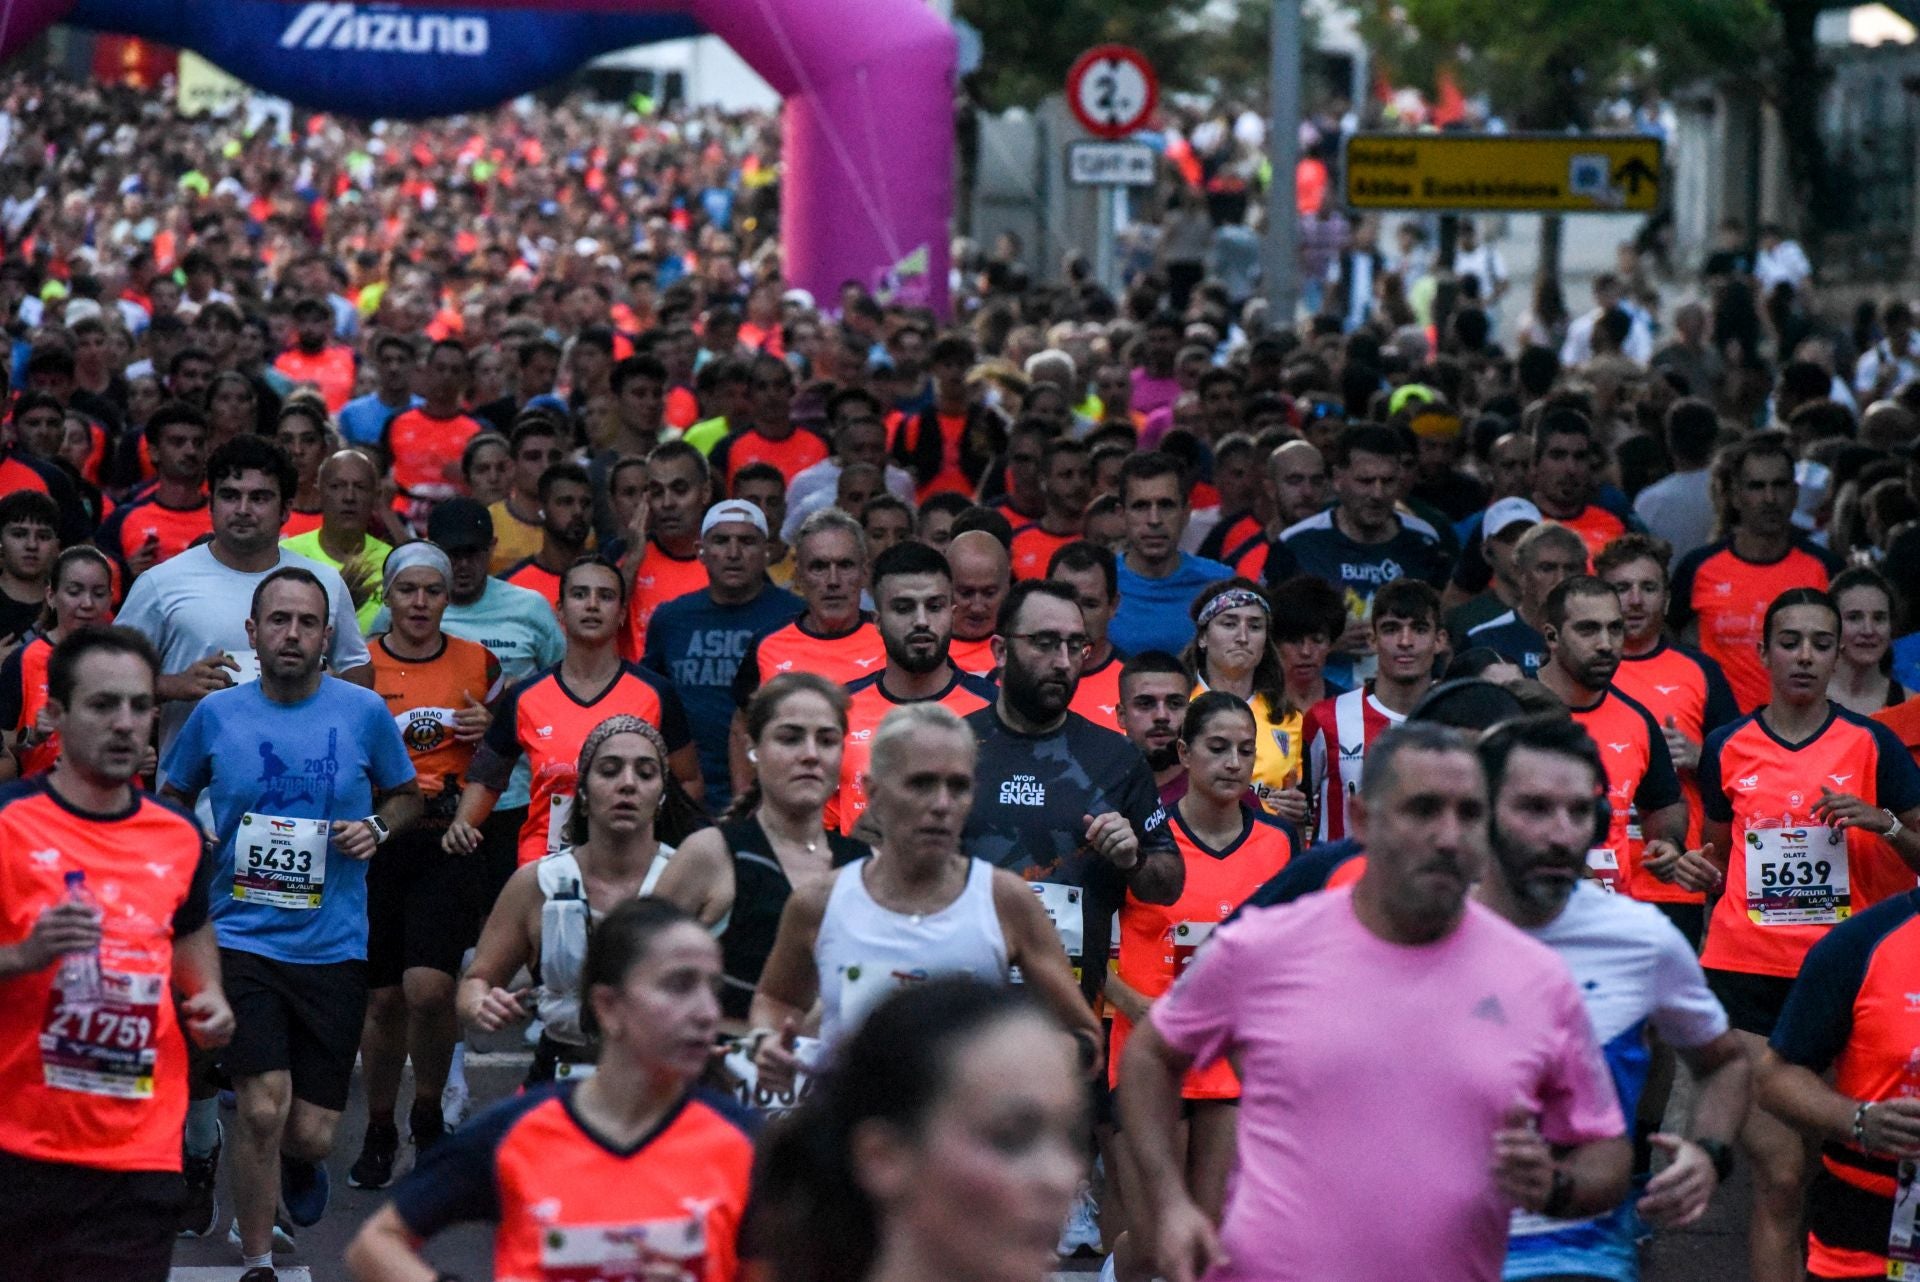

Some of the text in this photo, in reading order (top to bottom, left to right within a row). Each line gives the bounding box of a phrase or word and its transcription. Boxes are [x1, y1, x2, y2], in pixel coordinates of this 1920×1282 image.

[280, 2, 489, 55] MIZUNO
[409, 711, 443, 720] BILBAO
[1000, 781, 1045, 793] CHALL
[1013, 774, 1036, 782] WOP
[1000, 792, 1045, 806] ENGE
[248, 844, 312, 872] 5433
[1761, 860, 1832, 887] 5639
[47, 1003, 152, 1049] 21759
